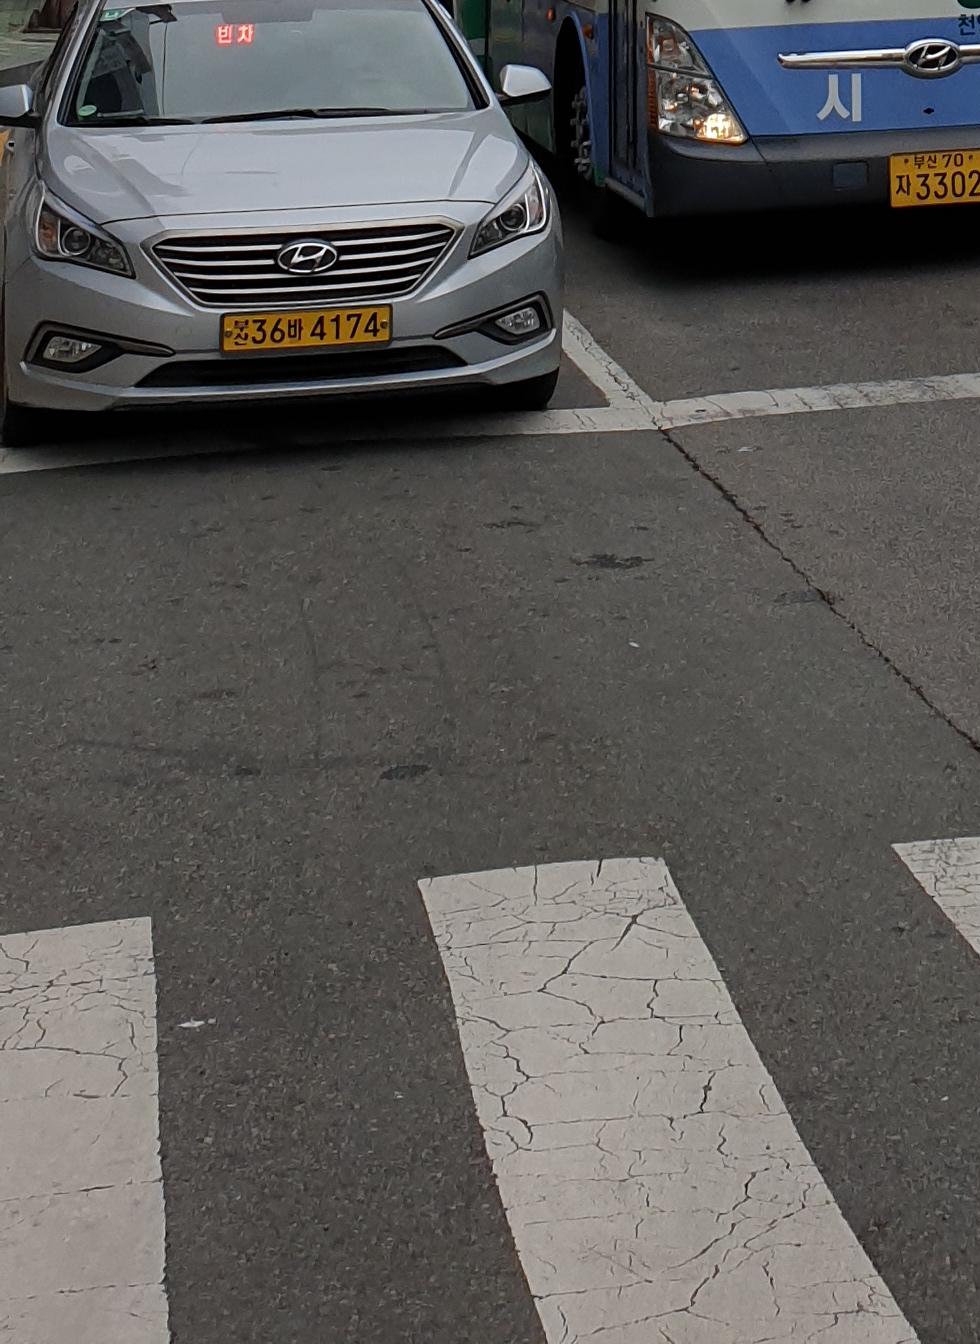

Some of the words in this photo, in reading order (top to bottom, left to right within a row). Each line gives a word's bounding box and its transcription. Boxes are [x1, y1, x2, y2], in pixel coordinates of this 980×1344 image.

[912, 155, 938, 170] 부산
[941, 152, 965, 168] 70
[309, 311, 381, 340] 4174
